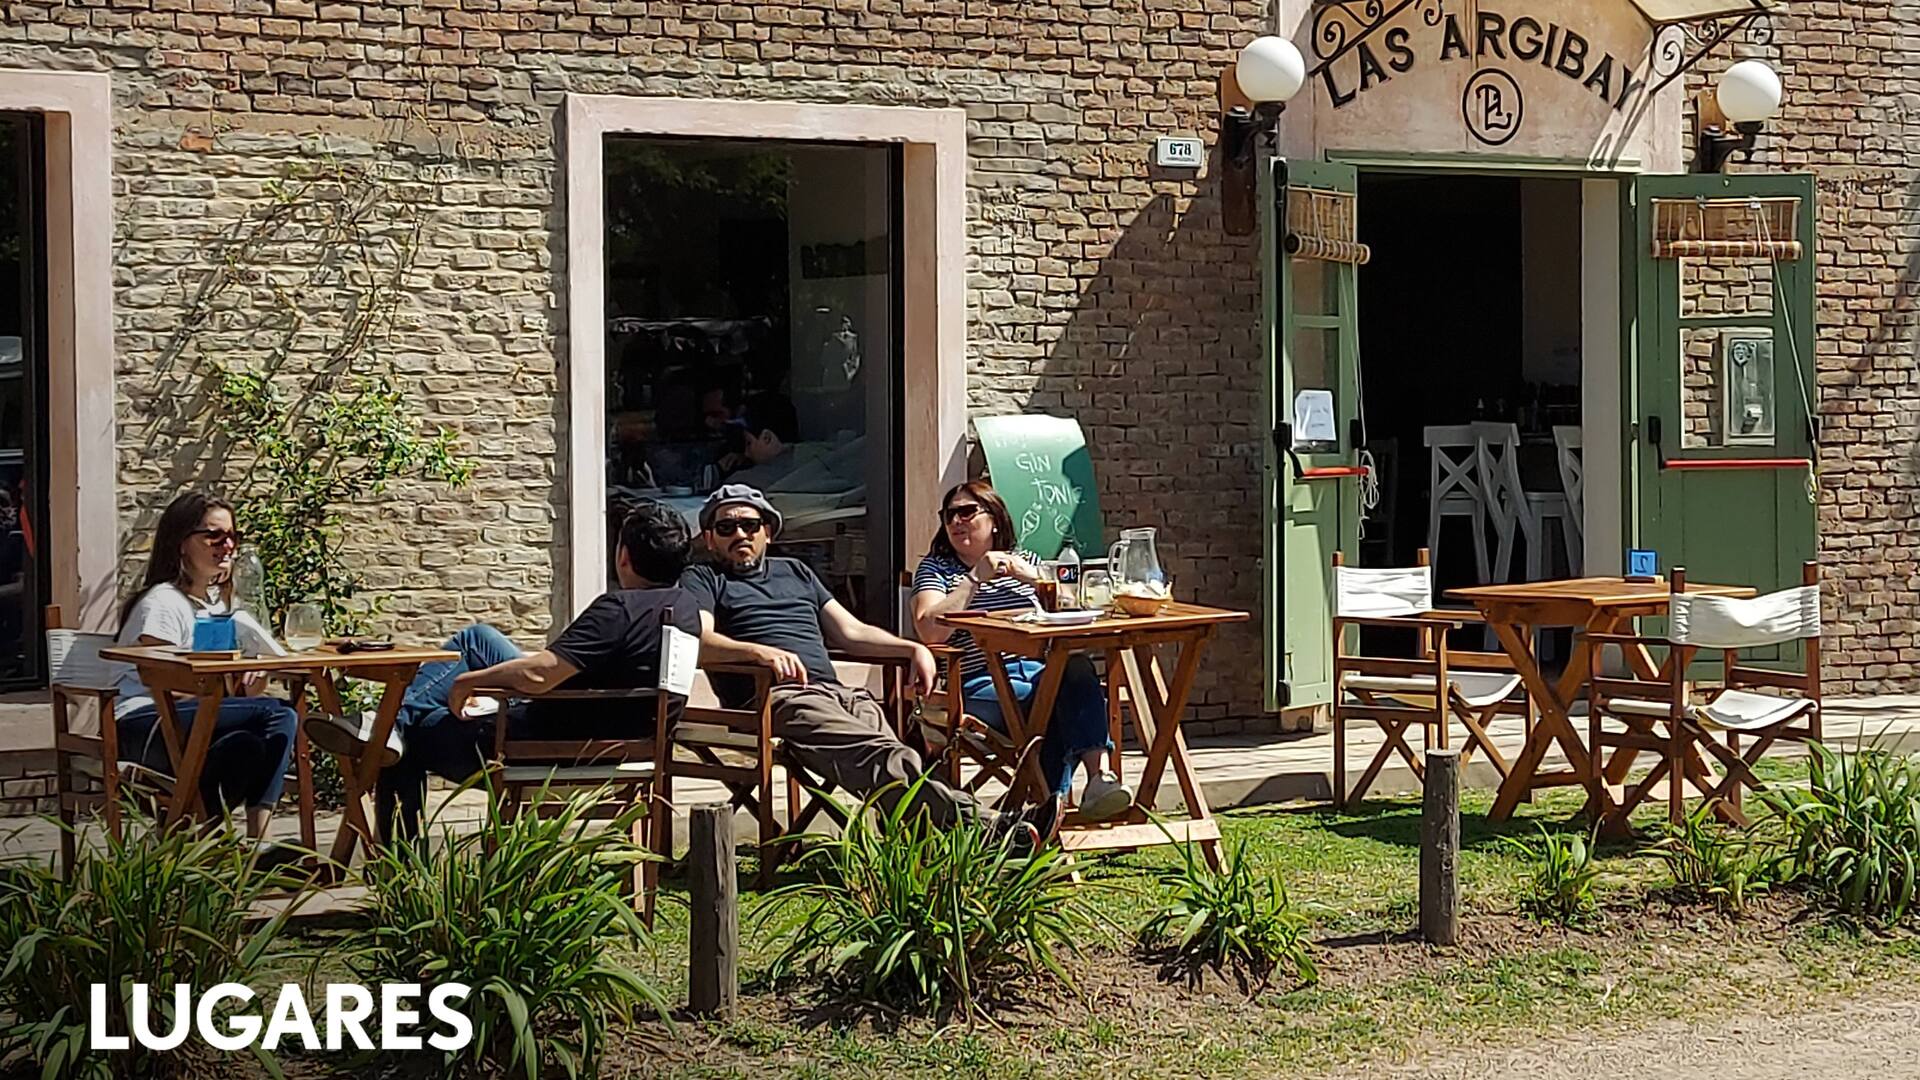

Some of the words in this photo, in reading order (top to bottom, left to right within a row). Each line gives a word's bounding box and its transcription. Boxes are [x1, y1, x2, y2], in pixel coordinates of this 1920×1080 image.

[1314, 27, 1414, 108] LAS
[1440, 11, 1645, 111] ARGIBAY
[1169, 143, 1191, 156] 678
[1015, 452, 1051, 473] GIN
